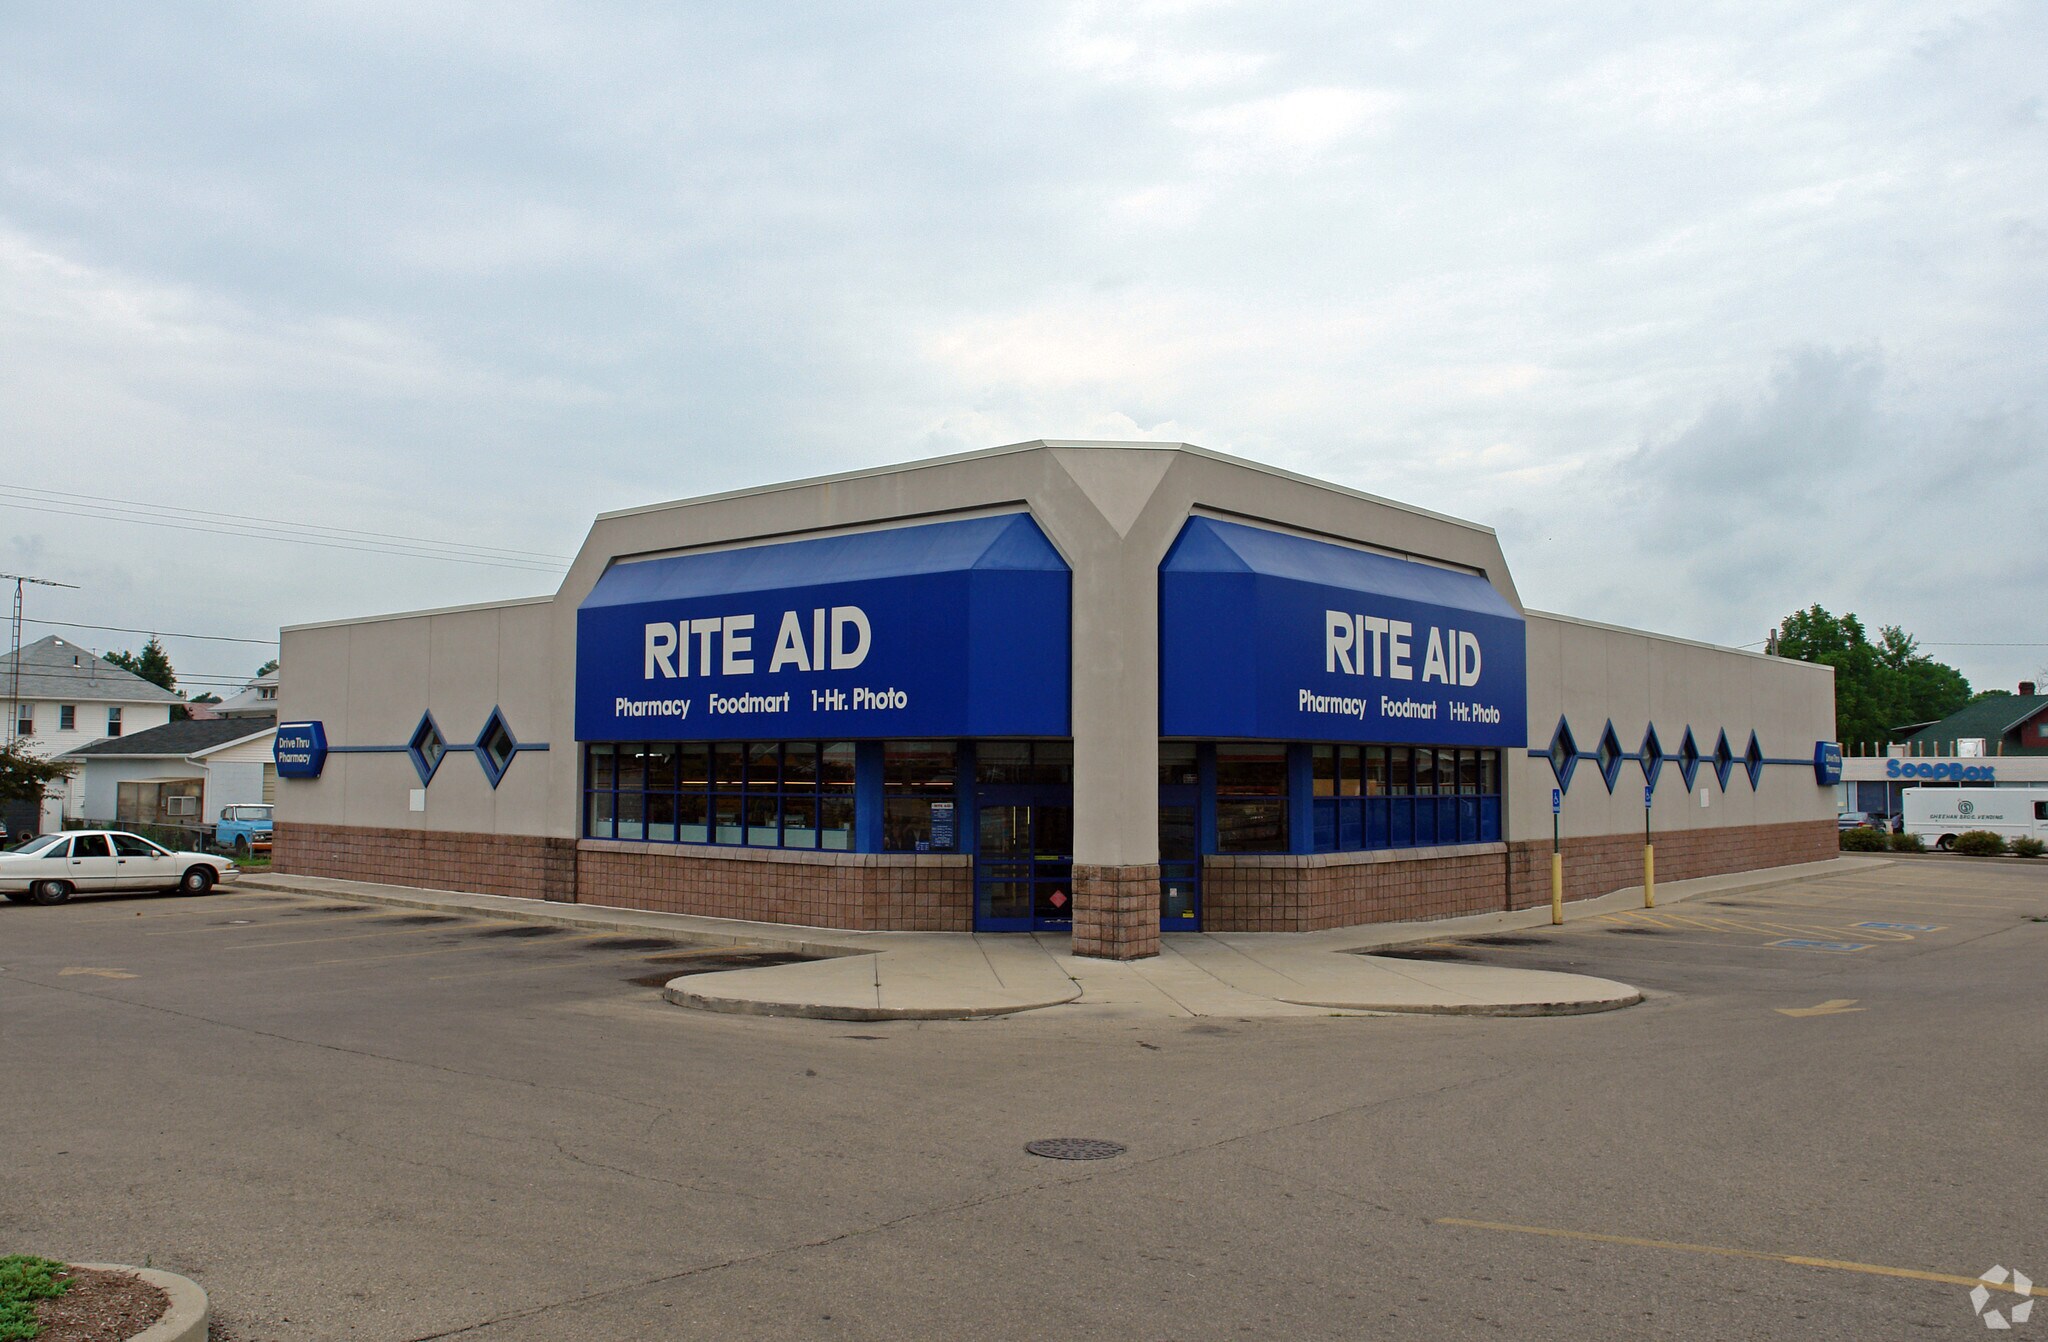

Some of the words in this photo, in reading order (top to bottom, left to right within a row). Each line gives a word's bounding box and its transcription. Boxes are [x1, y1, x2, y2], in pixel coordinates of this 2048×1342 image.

[644, 614, 755, 680] RITE
[768, 605, 872, 673] AID
[1325, 609, 1413, 681] RITE
[1421, 626, 1482, 687] AID
[615, 697, 691, 720] Pharmacy
[709, 691, 790, 715] Foodmart
[811, 688, 849, 711] 1-Hr.
[853, 687, 908, 711] Photo
[1299, 688, 1367, 721] Pharmacy
[1381, 695, 1437, 720] Foodmart
[1449, 701, 1471, 722] 1-Hr.
[1472, 703, 1500, 724] Photo
[278, 751, 311, 766] Pharmacy
[279, 737, 295, 748] Drive
[295, 737, 310, 748] Thru
